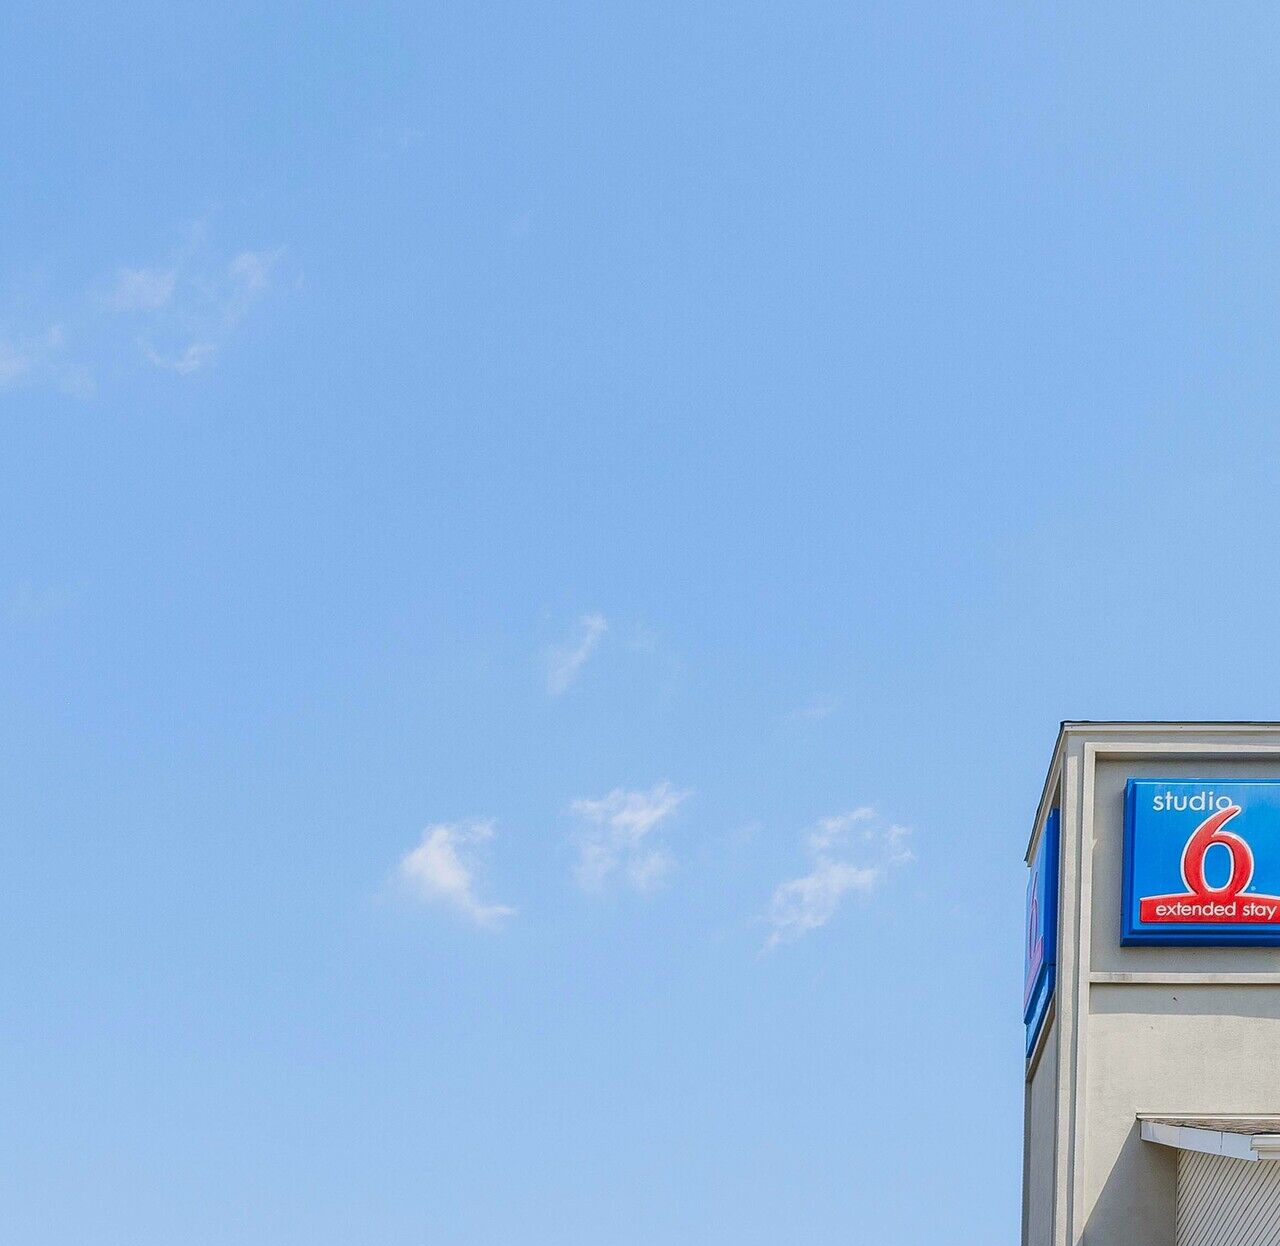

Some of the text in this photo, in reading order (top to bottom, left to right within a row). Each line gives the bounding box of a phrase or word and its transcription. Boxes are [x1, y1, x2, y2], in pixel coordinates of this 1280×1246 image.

[1152, 791, 1233, 811] studio
[1180, 805, 1255, 897] 6
[1155, 902, 1277, 919] extended stay
